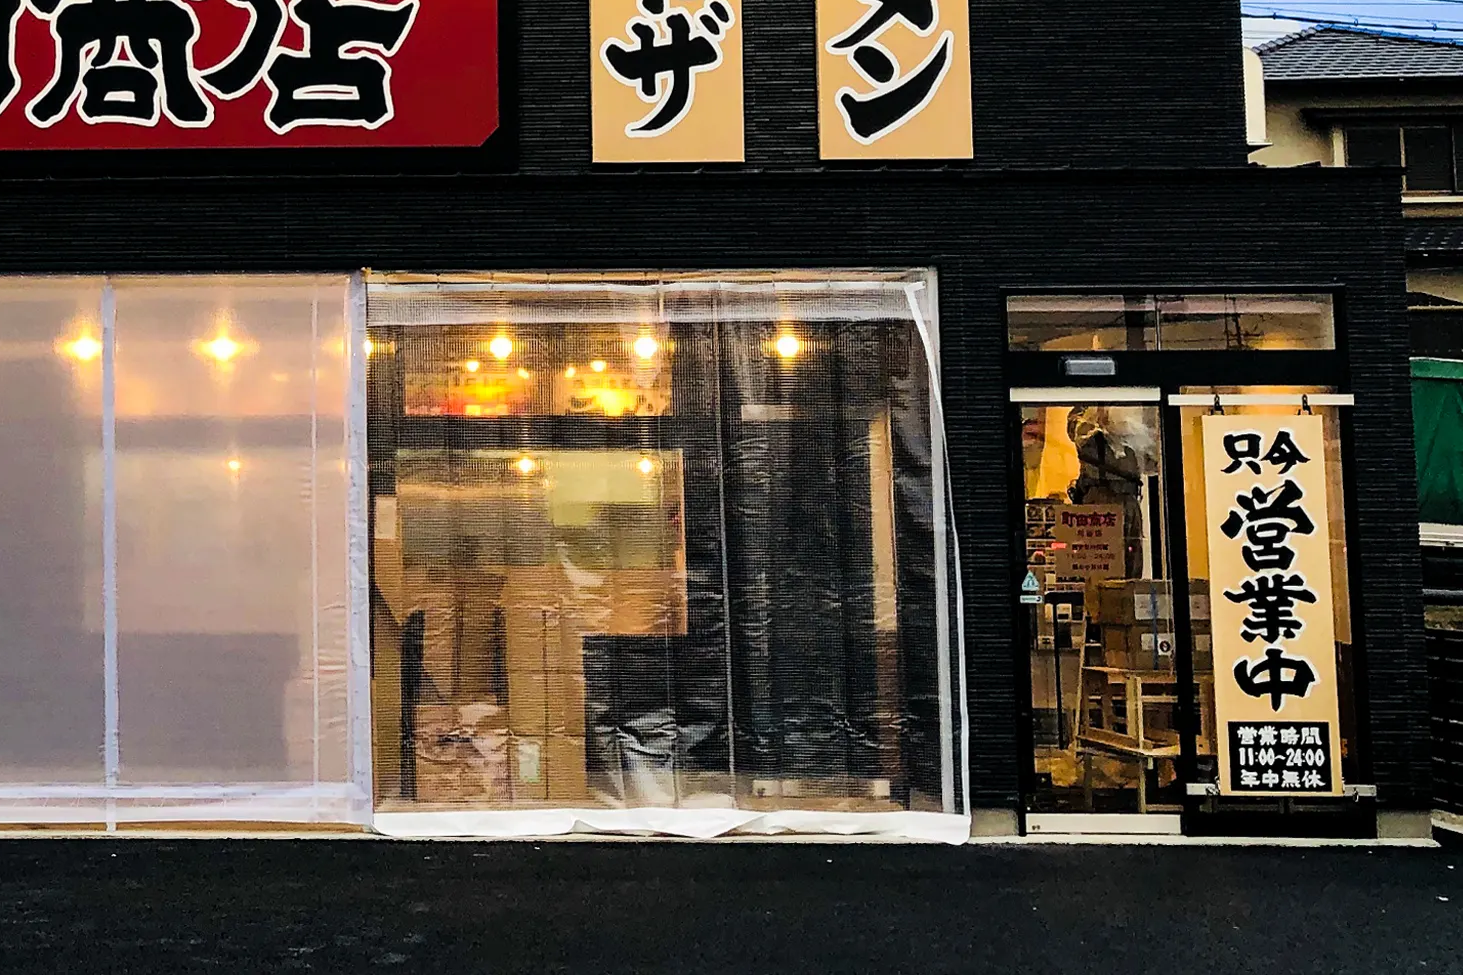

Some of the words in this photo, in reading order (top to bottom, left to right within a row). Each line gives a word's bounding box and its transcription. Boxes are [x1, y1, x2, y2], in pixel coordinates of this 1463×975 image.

[1220, 430, 1312, 475] 只今
[1220, 478, 1318, 712] 営業中
[1237, 725, 1323, 746] 営業時間
[1240, 769, 1326, 788] 年中無休
